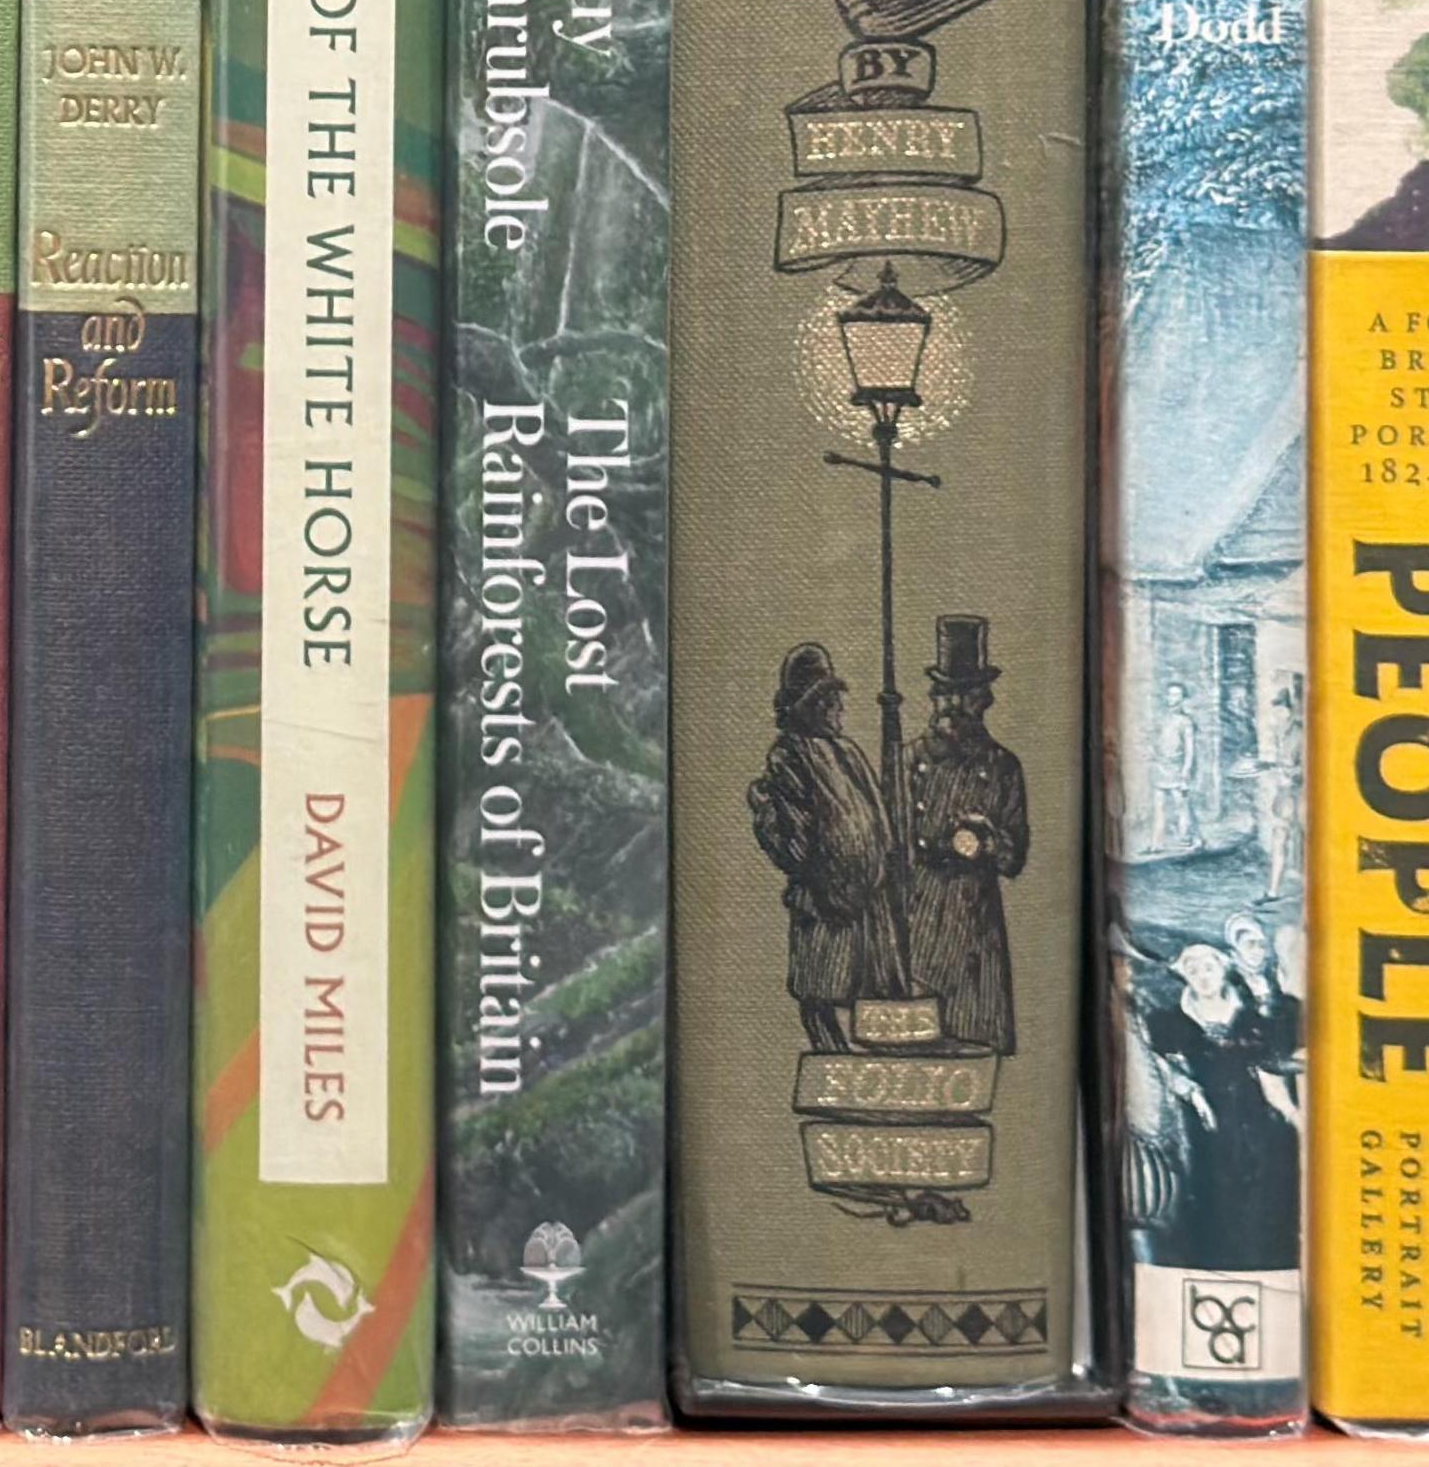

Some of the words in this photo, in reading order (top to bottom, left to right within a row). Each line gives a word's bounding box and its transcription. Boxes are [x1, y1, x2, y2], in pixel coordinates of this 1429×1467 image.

[43, 46, 140, 83] JOHN
[150, 45, 186, 81] W.
[854, 49, 918, 82] BY
[1156, 3, 1284, 51] Dodd
[59, 94, 167, 129] DERRY
[307, 79, 357, 198] THE
[806, 121, 964, 160] HENRY
[31, 231, 189, 290] Reaction
[81, 297, 145, 351] and
[304, 223, 355, 428] WHITE
[1368, 313, 1388, 332] A
[41, 357, 177, 437] Reform
[565, 398, 631, 531] The
[303, 461, 353, 667] HORSE
[480, 401, 545, 766] Rainforests
[563, 551, 631, 695] Lost
[480, 785, 545, 856] of
[304, 793, 346, 953] DAVID
[479, 878, 543, 1096] Britain
[303, 976, 345, 1122] MILES
[1360, 1129, 1384, 1311] GALLERY
[1399, 1131, 1422, 1338] PORTRAIT
[507, 1313, 598, 1332] WILLIAM
[507, 1337, 599, 1355] COLLINS
